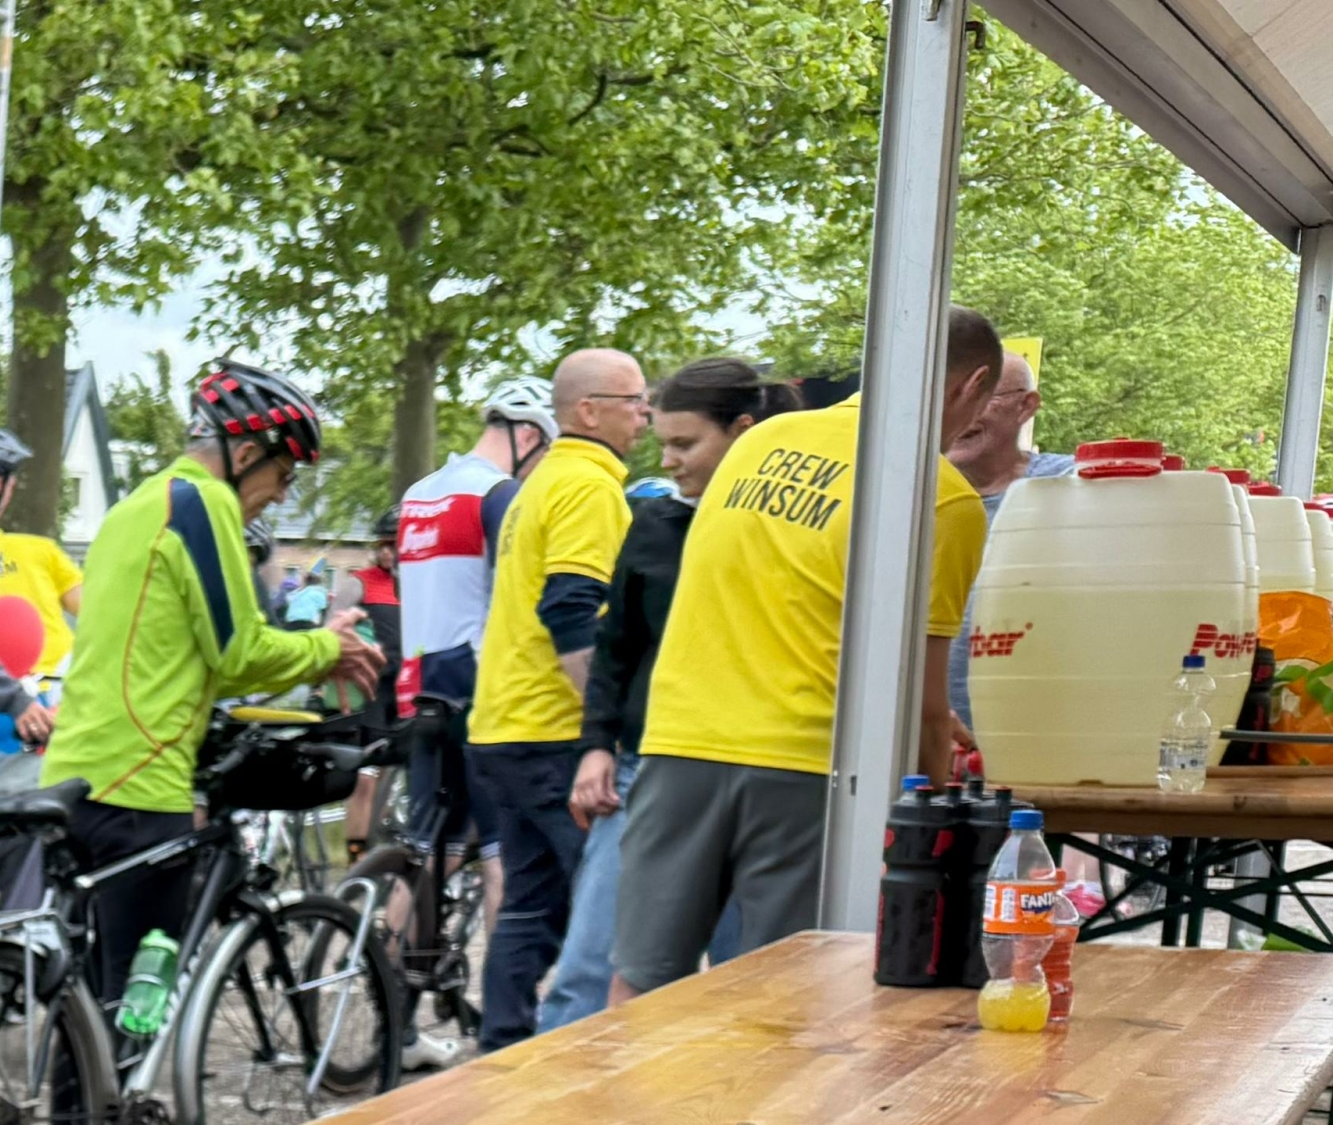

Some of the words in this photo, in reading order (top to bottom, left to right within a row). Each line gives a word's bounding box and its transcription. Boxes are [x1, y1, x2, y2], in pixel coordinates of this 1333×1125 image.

[757, 447, 850, 490] CREW
[723, 477, 843, 532] WINSUM
[1020, 891, 1056, 909] FANT
